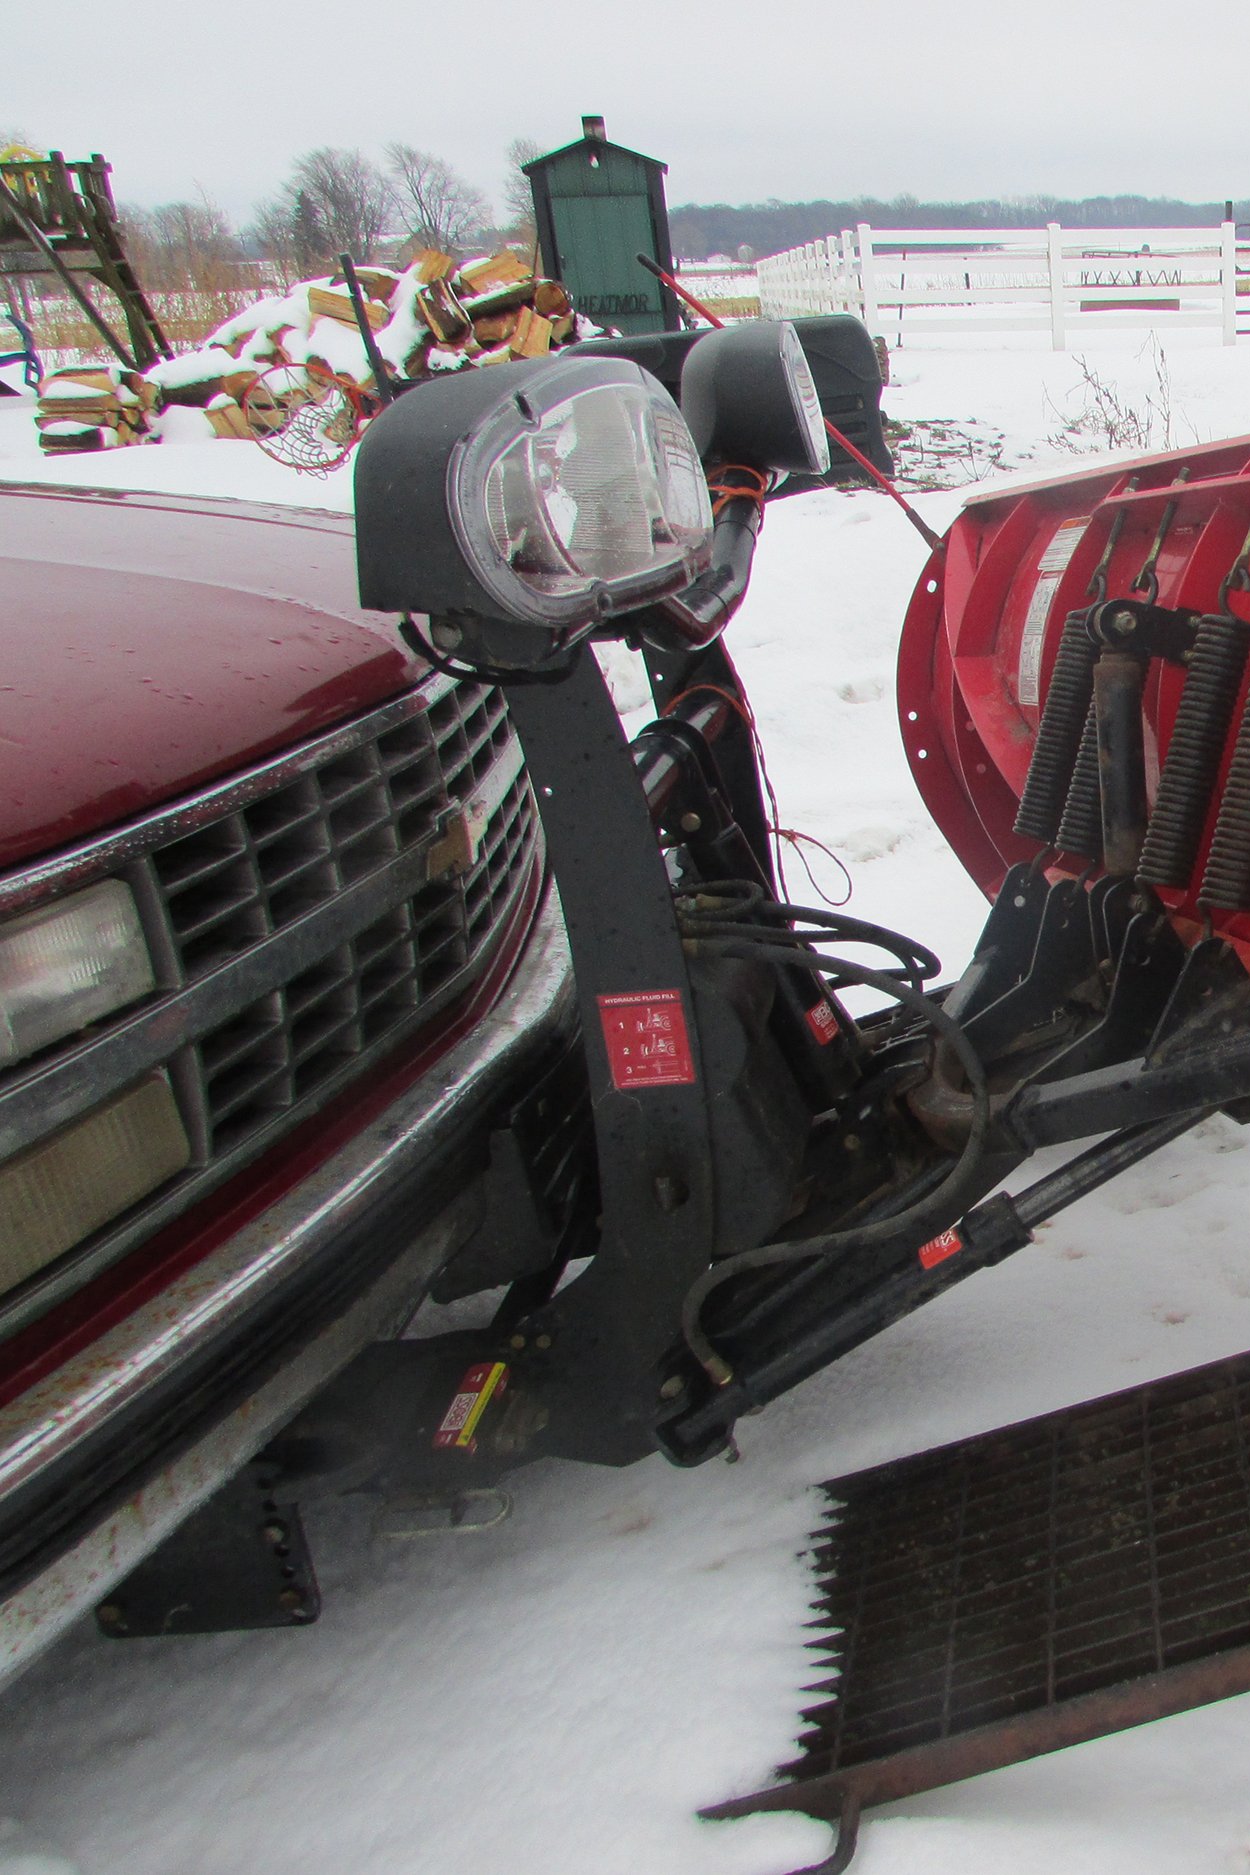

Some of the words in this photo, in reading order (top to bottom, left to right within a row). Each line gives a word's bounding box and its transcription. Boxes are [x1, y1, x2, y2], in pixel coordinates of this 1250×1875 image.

[578, 294, 649, 313] HEATMOR
[604, 995, 641, 1004] HYDRAULIC
[619, 1021, 625, 1029] 1
[623, 1047, 630, 1055] 2
[626, 1066, 633, 1074] 3
